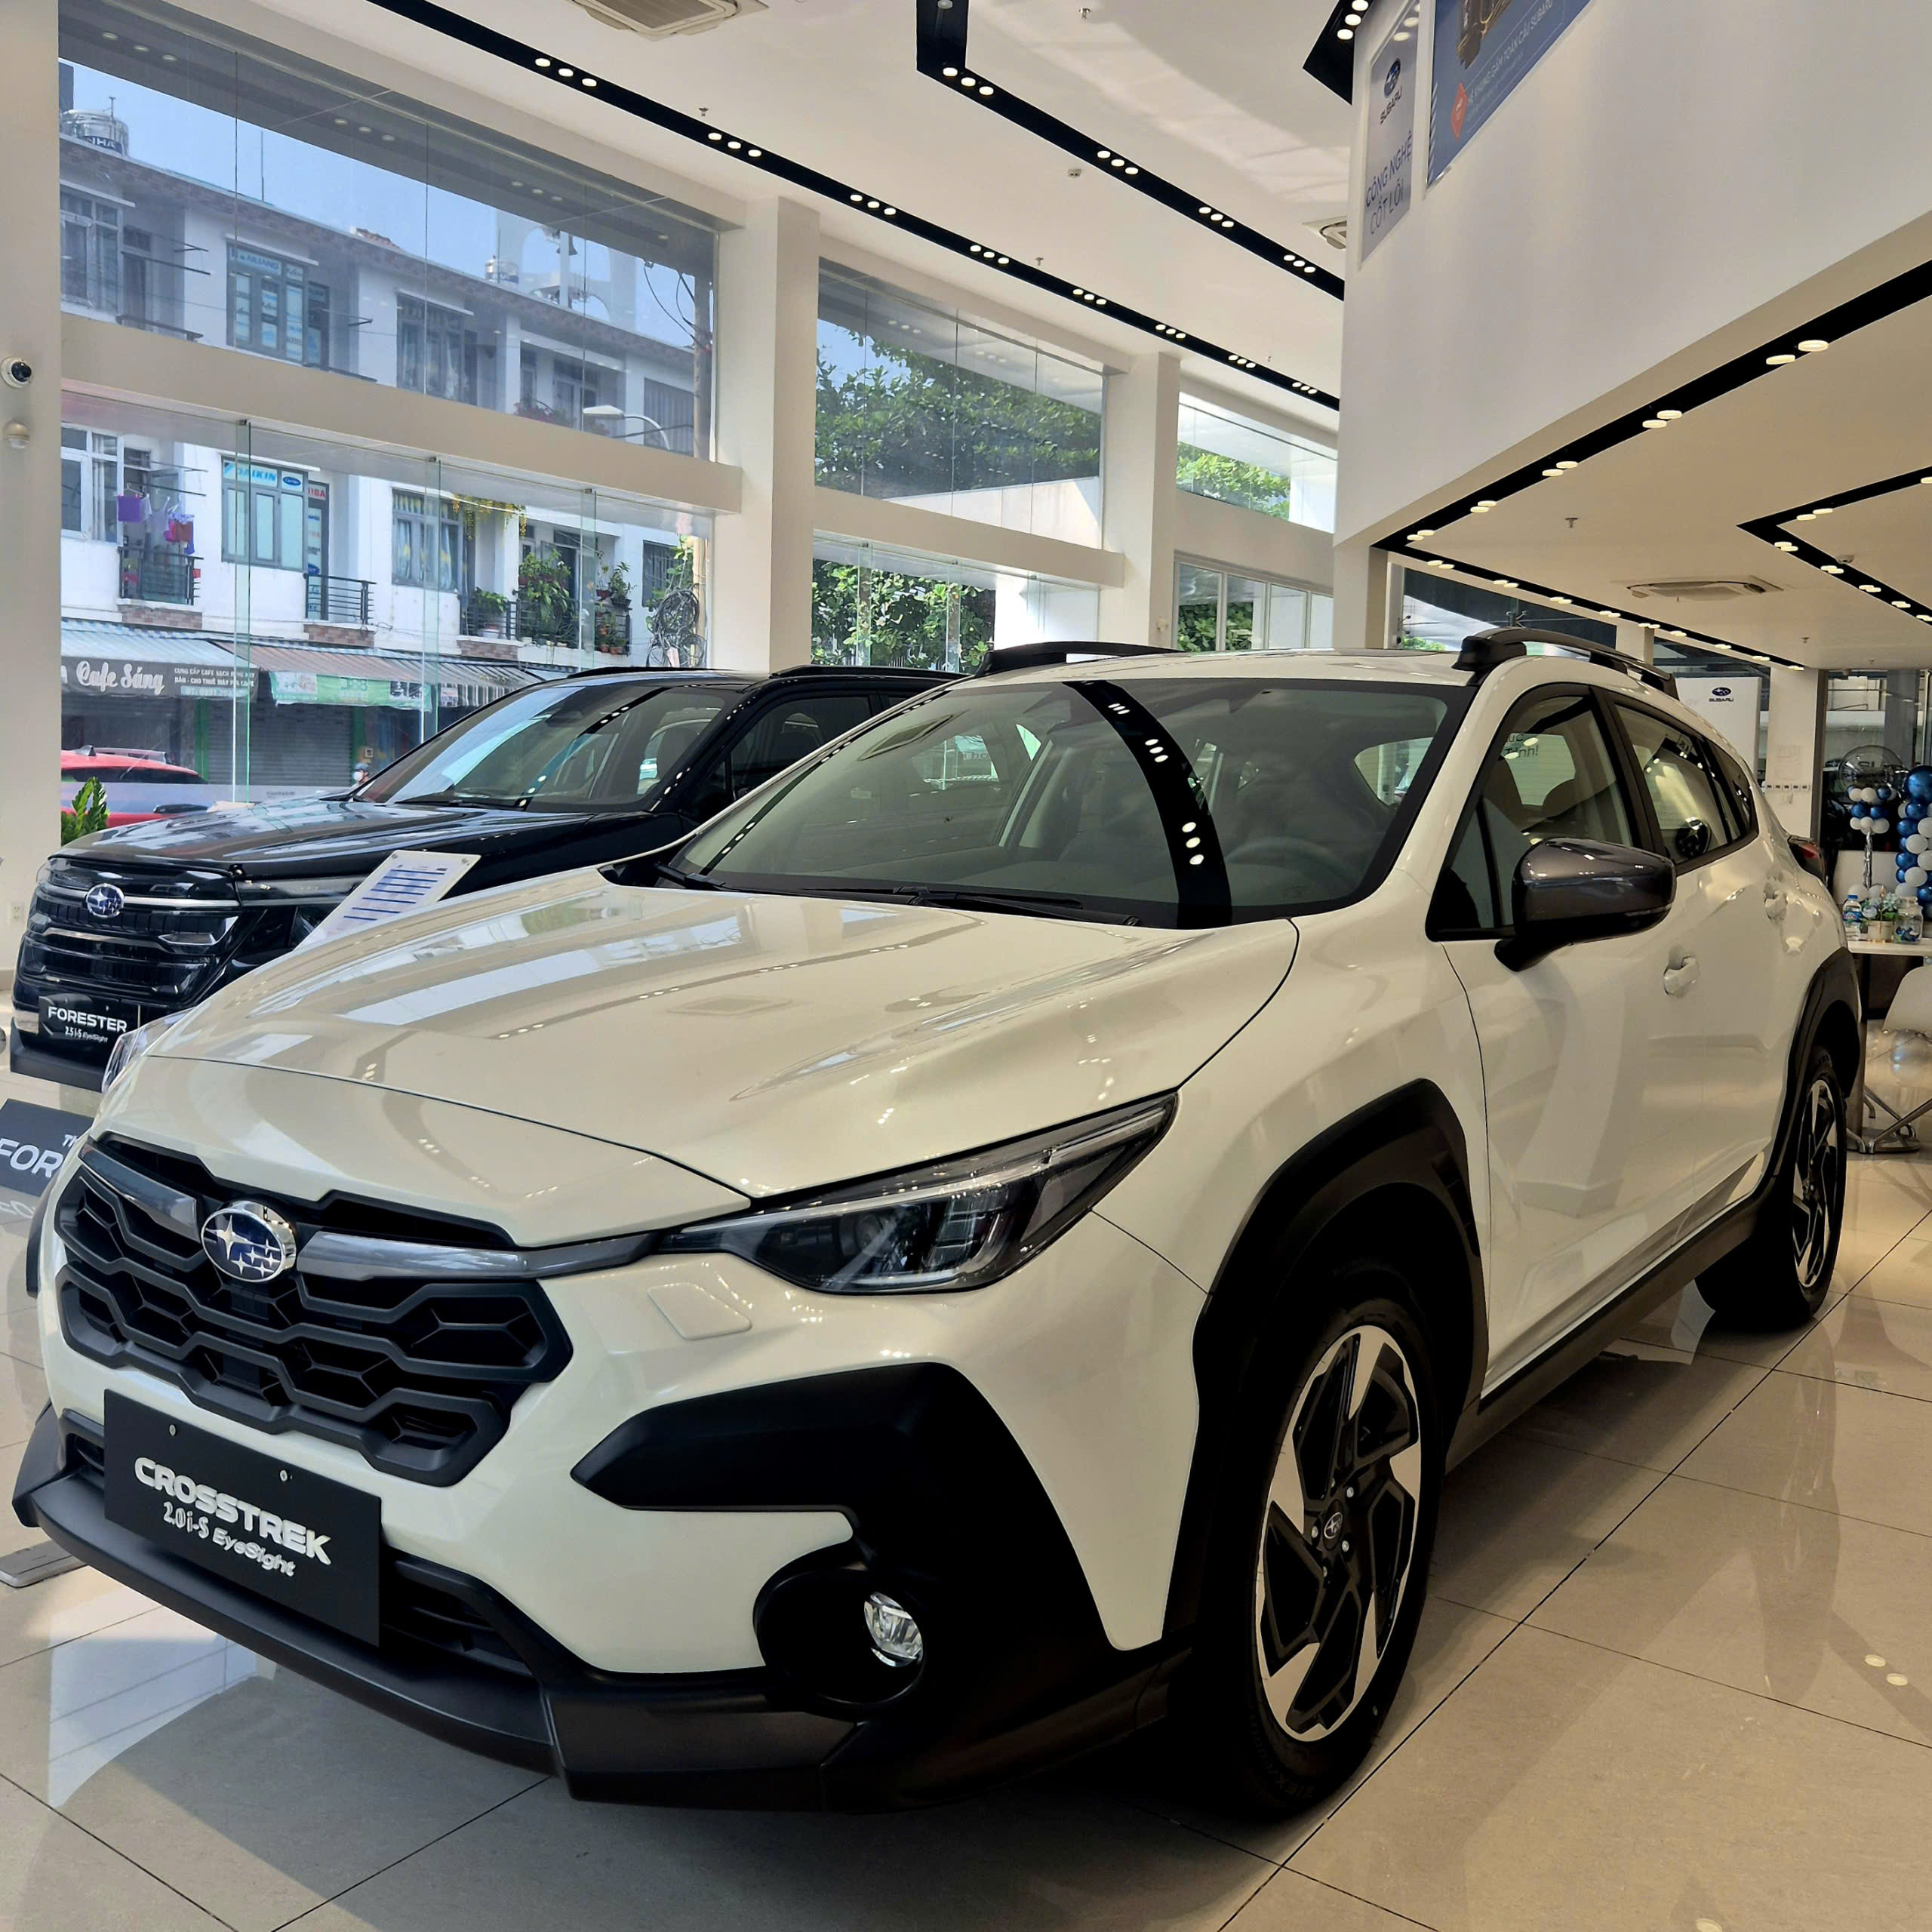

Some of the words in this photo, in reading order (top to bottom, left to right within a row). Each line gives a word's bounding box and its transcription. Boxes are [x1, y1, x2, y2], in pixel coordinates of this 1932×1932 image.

[1380, 86, 1402, 125] SUBARU
[1366, 167, 1388, 208] CÔNG
[1389, 130, 1412, 180] NGHỆ
[76, 660, 118, 692] Cafe
[121, 663, 165, 695] Sáng
[48, 1006, 127, 1032] FORESTER
[134, 1457, 331, 1565] CROSSTREK
[212, 1527, 296, 1577] EyeSight
